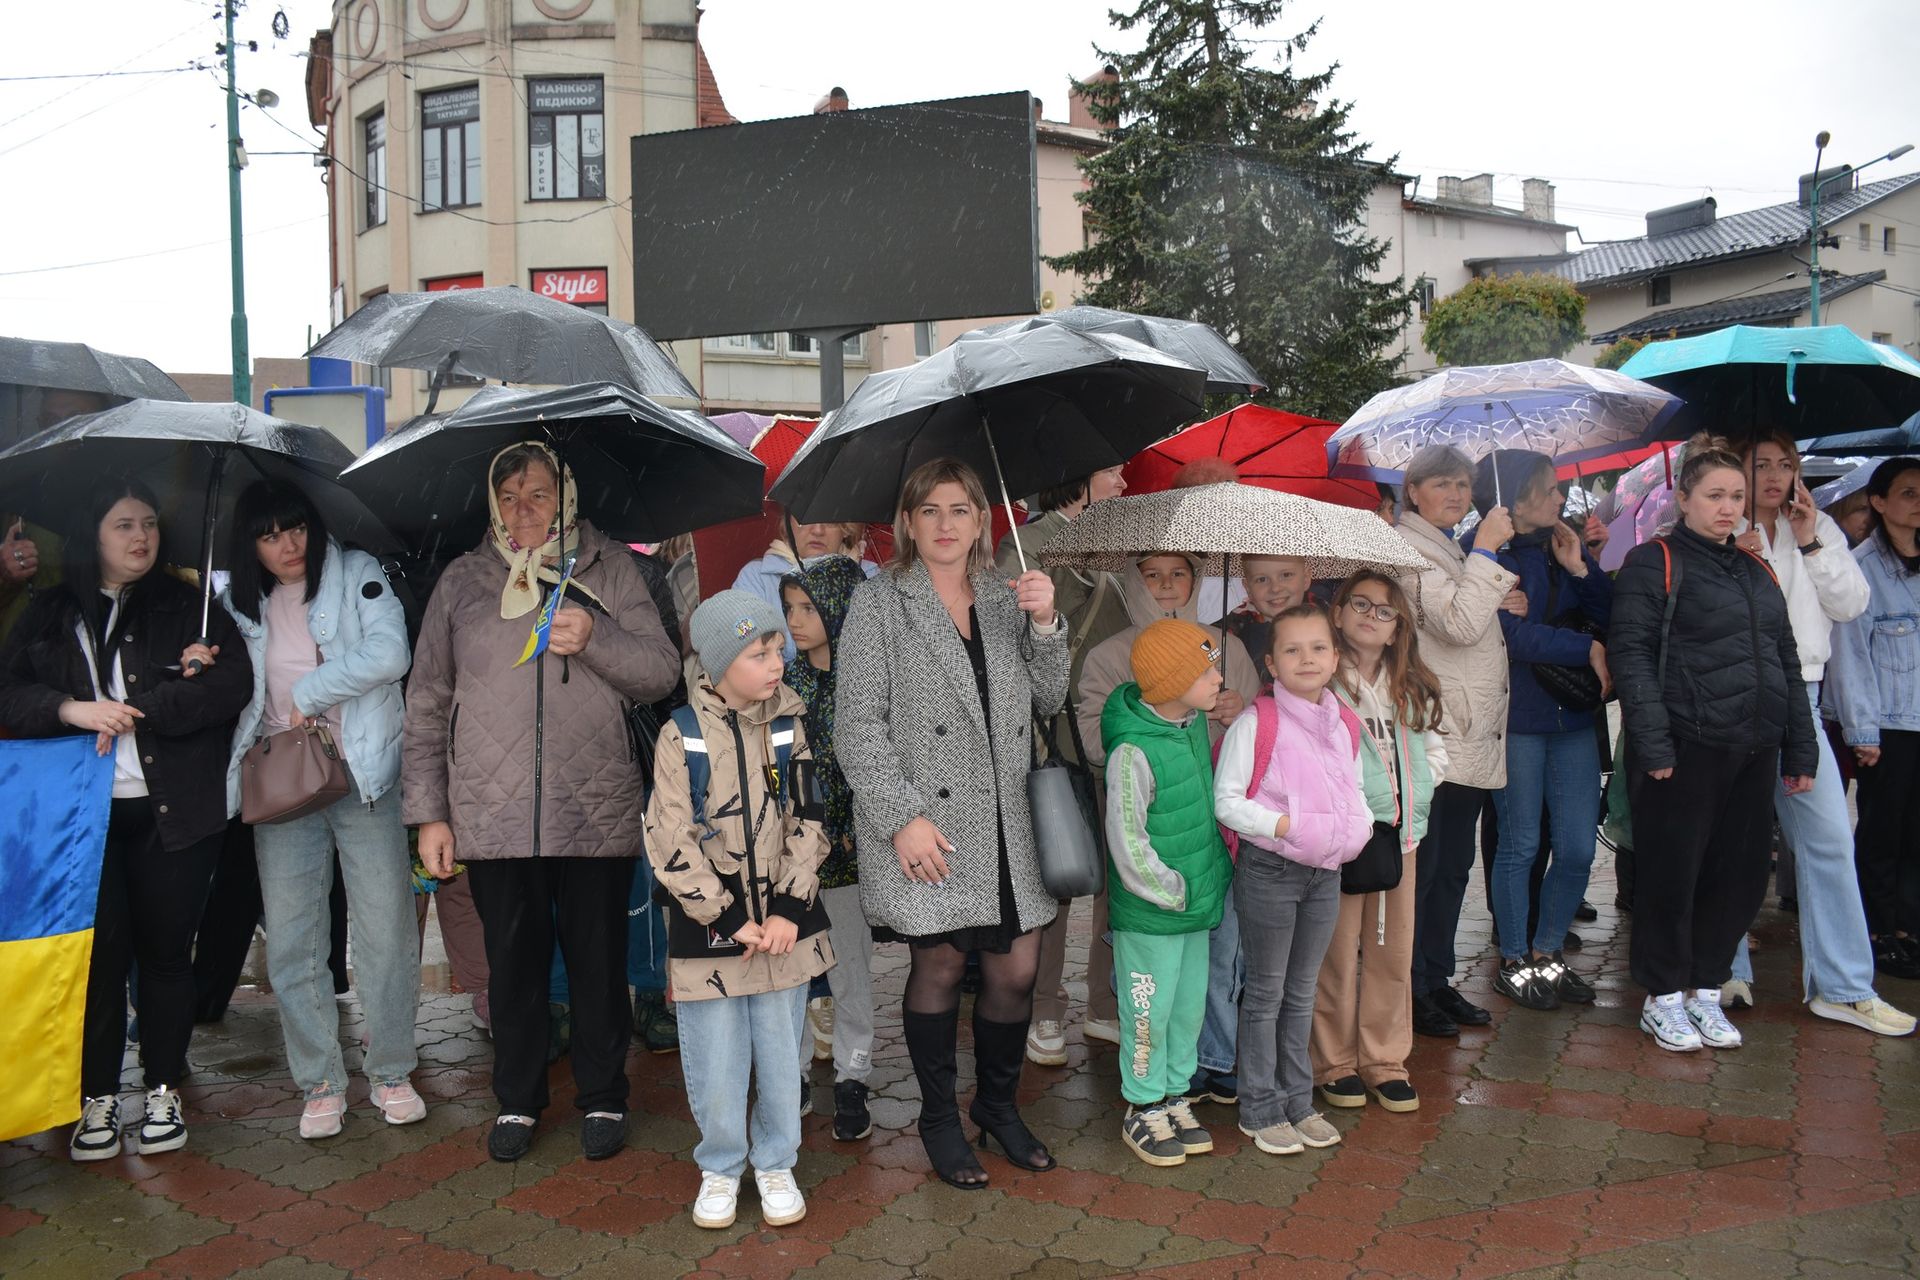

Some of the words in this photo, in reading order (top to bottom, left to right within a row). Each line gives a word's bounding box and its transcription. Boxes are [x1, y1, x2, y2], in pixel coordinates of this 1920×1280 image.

[424, 91, 477, 107] ВИДАЛЕННЯ
[535, 96, 596, 107] ПЕДИКЮР
[437, 109, 468, 119] ТАТУАЖУ
[542, 273, 599, 301] Style
